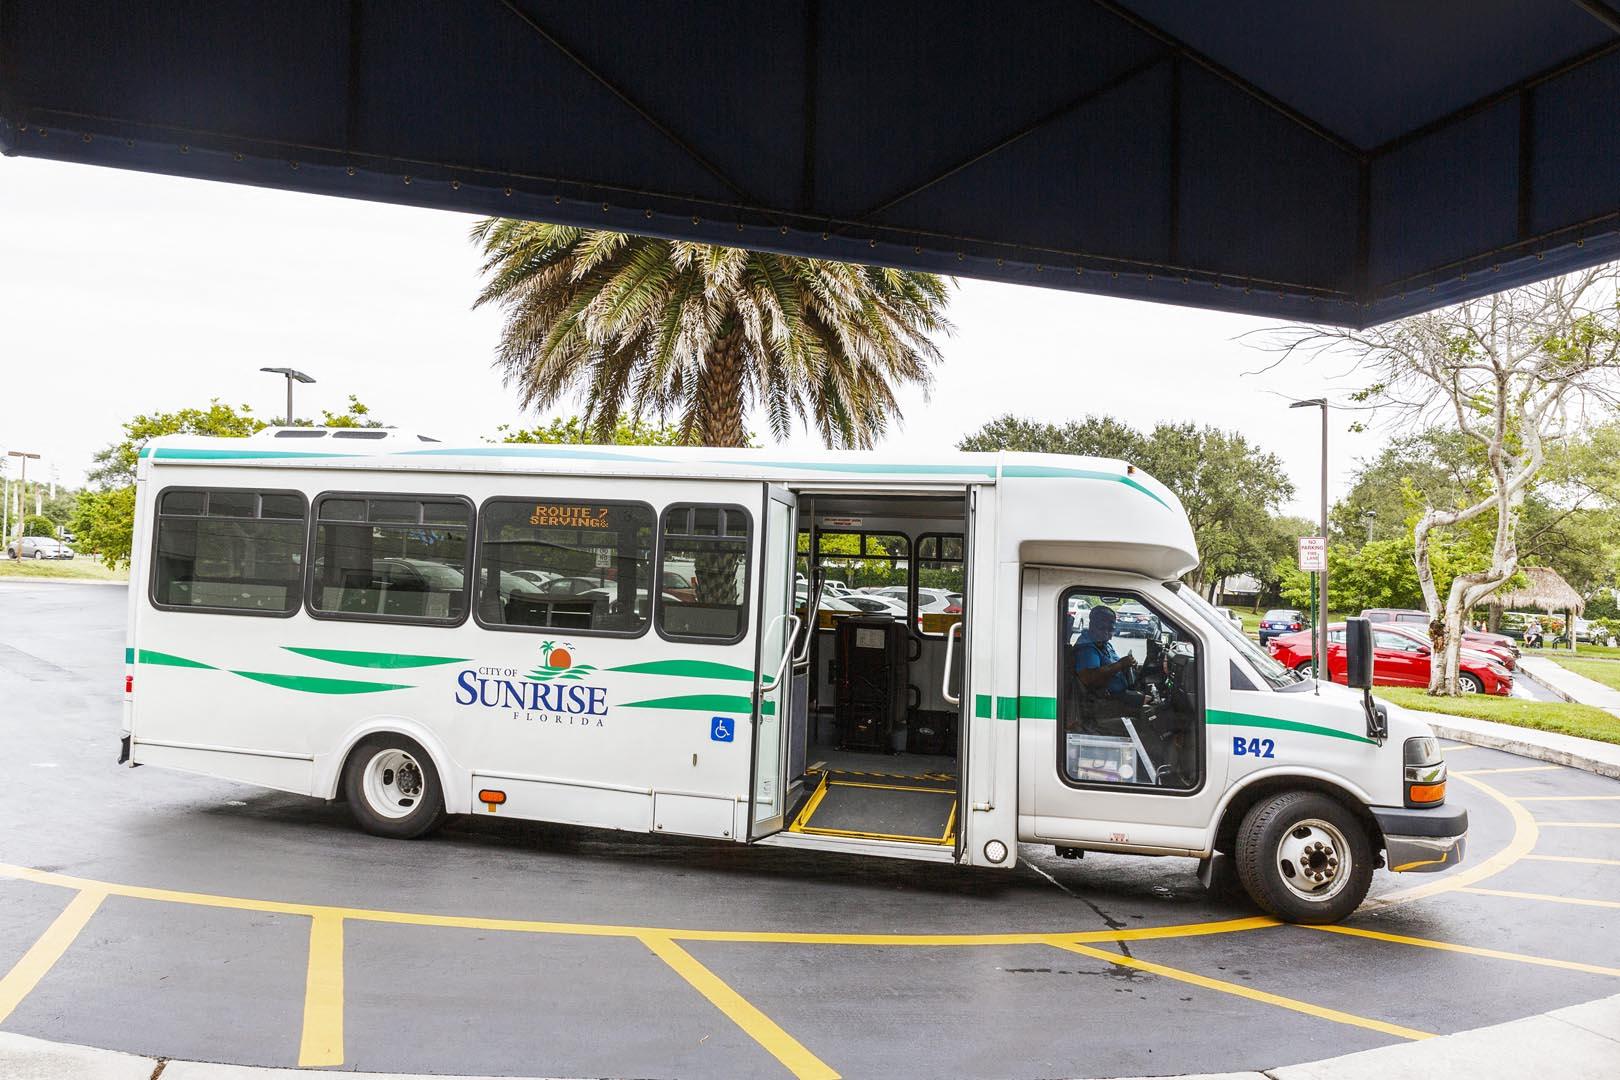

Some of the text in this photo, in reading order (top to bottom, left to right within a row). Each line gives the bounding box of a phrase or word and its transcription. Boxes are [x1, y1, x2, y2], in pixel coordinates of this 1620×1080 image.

[535, 505, 608, 519] ROUTE 7
[478, 666, 518, 678] CITY OF
[455, 669, 609, 716] SUNRISE
[513, 711, 604, 727] FLORIDA
[1232, 736, 1275, 759] B42
